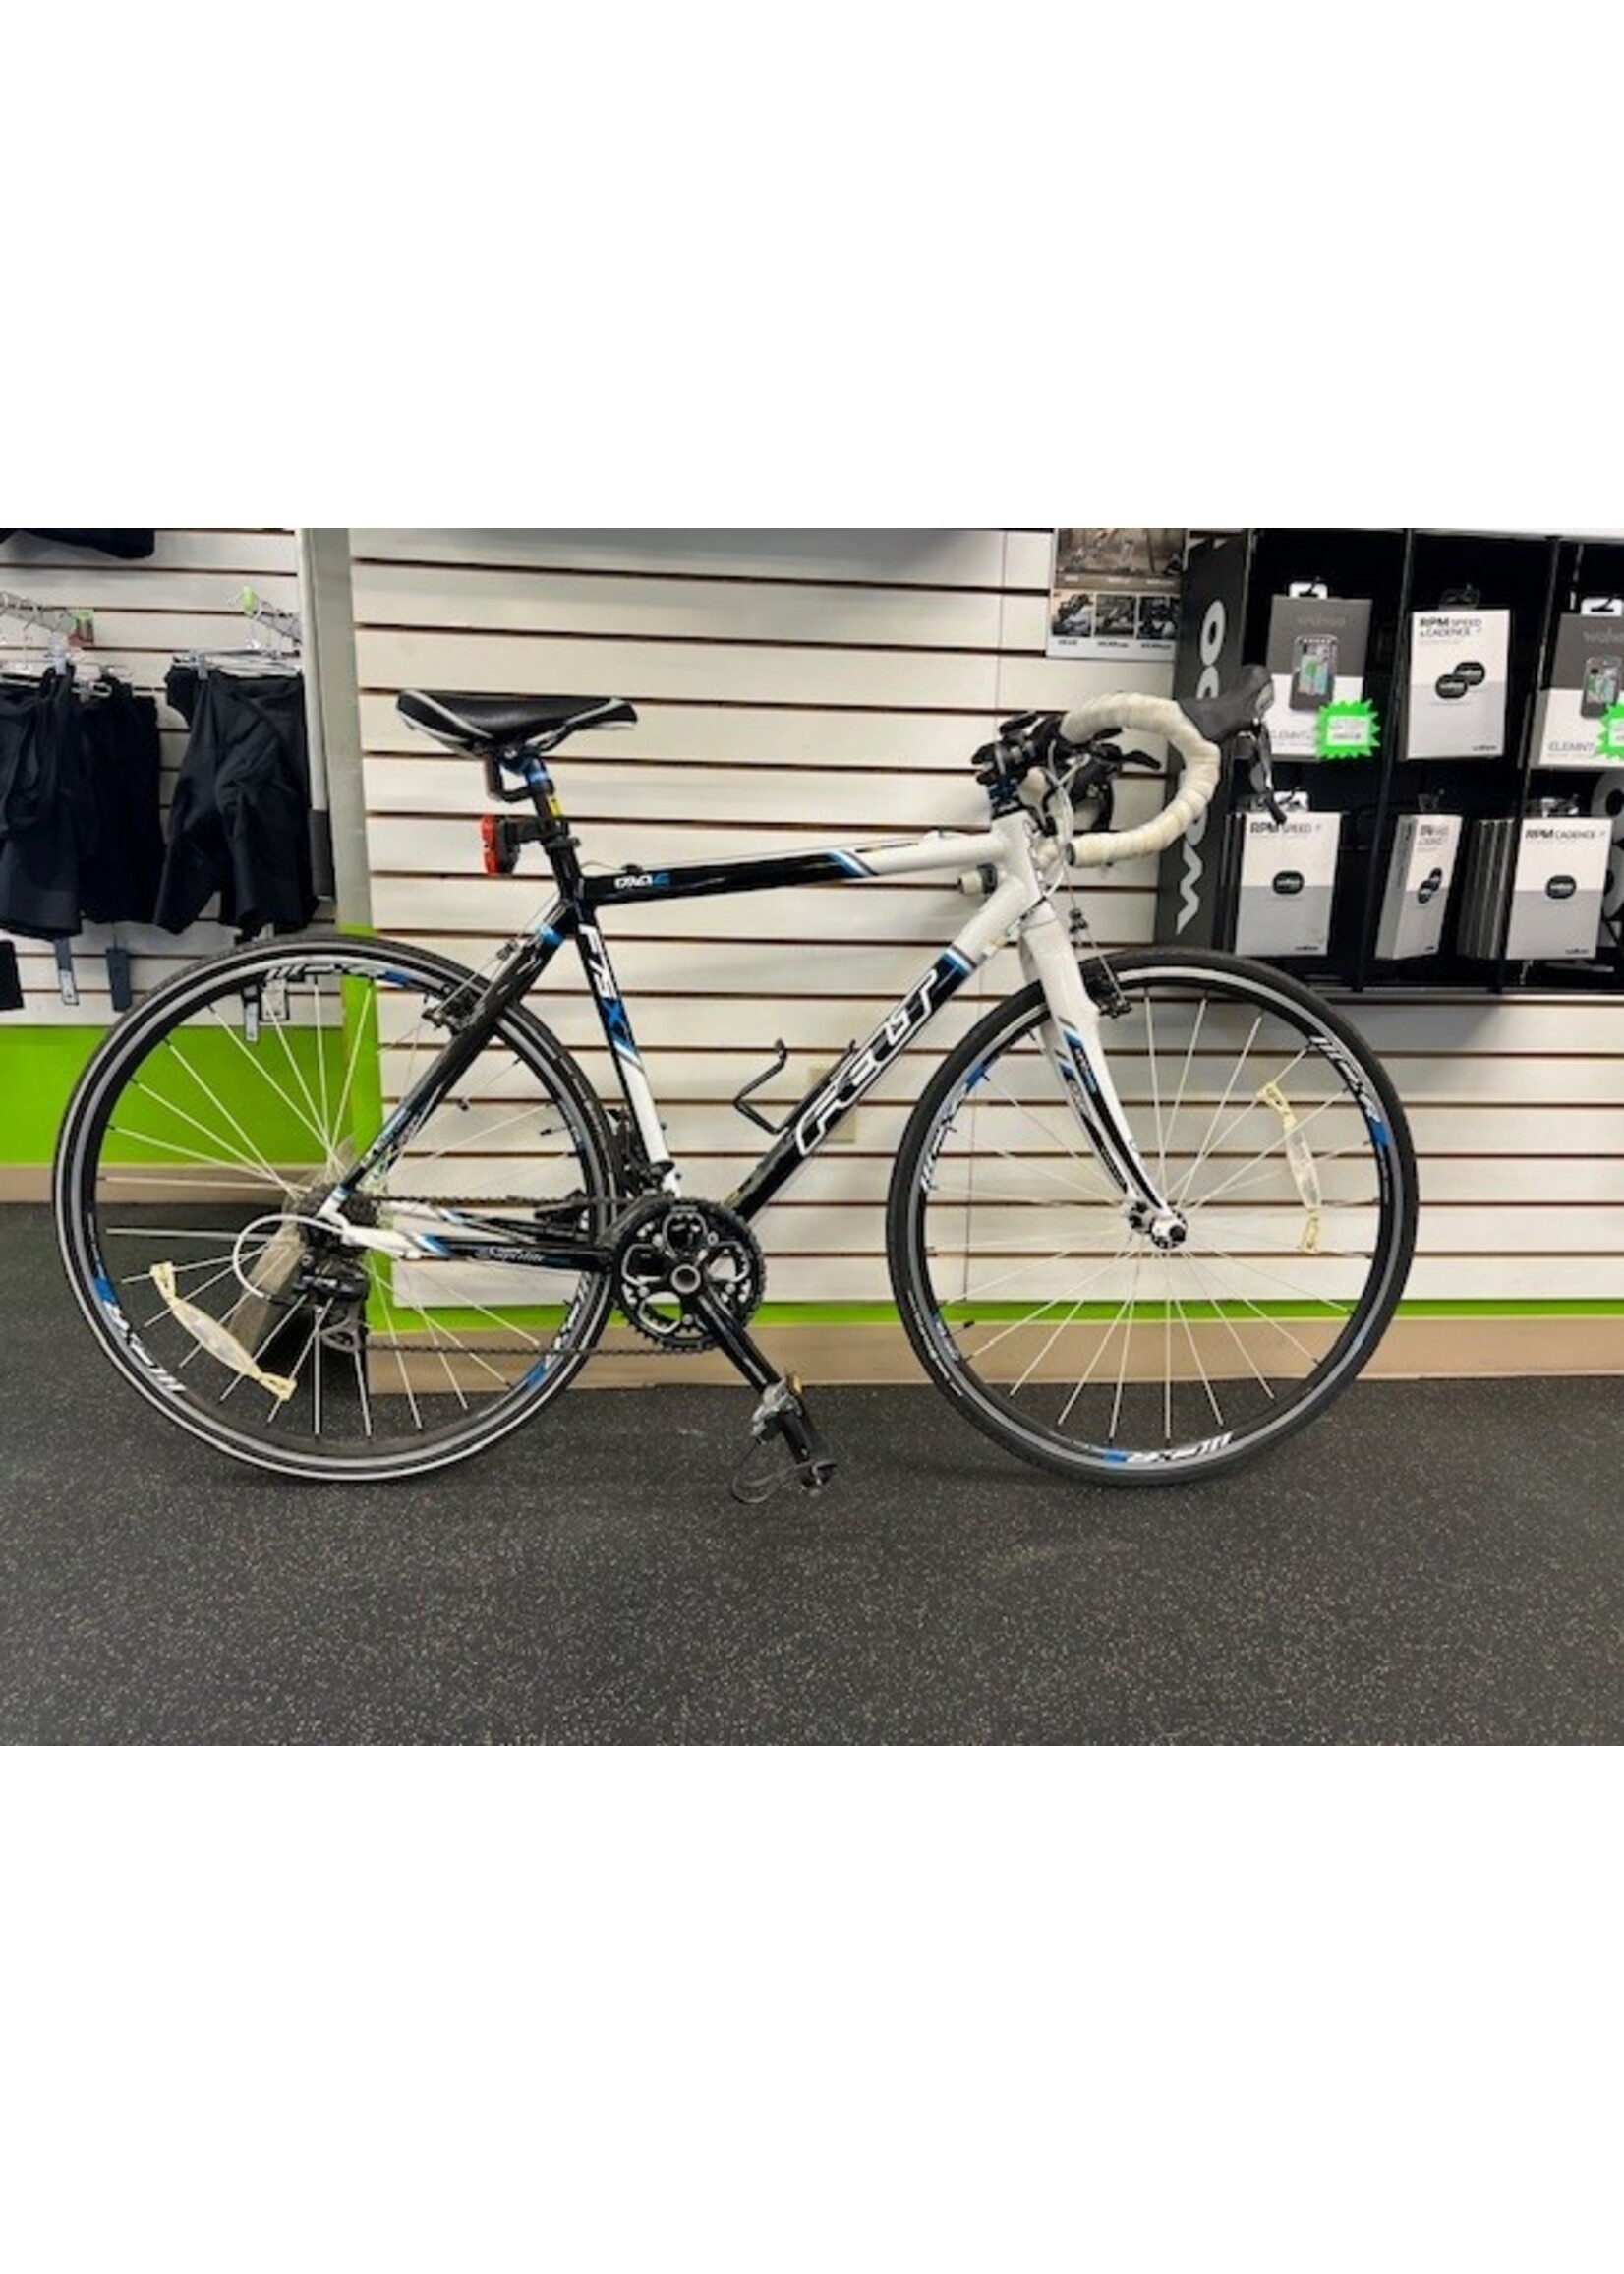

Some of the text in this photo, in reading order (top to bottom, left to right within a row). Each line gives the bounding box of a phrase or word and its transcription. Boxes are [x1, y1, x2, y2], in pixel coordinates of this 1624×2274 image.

[1420, 617, 1482, 628] RPM SPEED
[1249, 822, 1279, 834] RPM
[1525, 829, 1596, 839] RPM CADENCE
